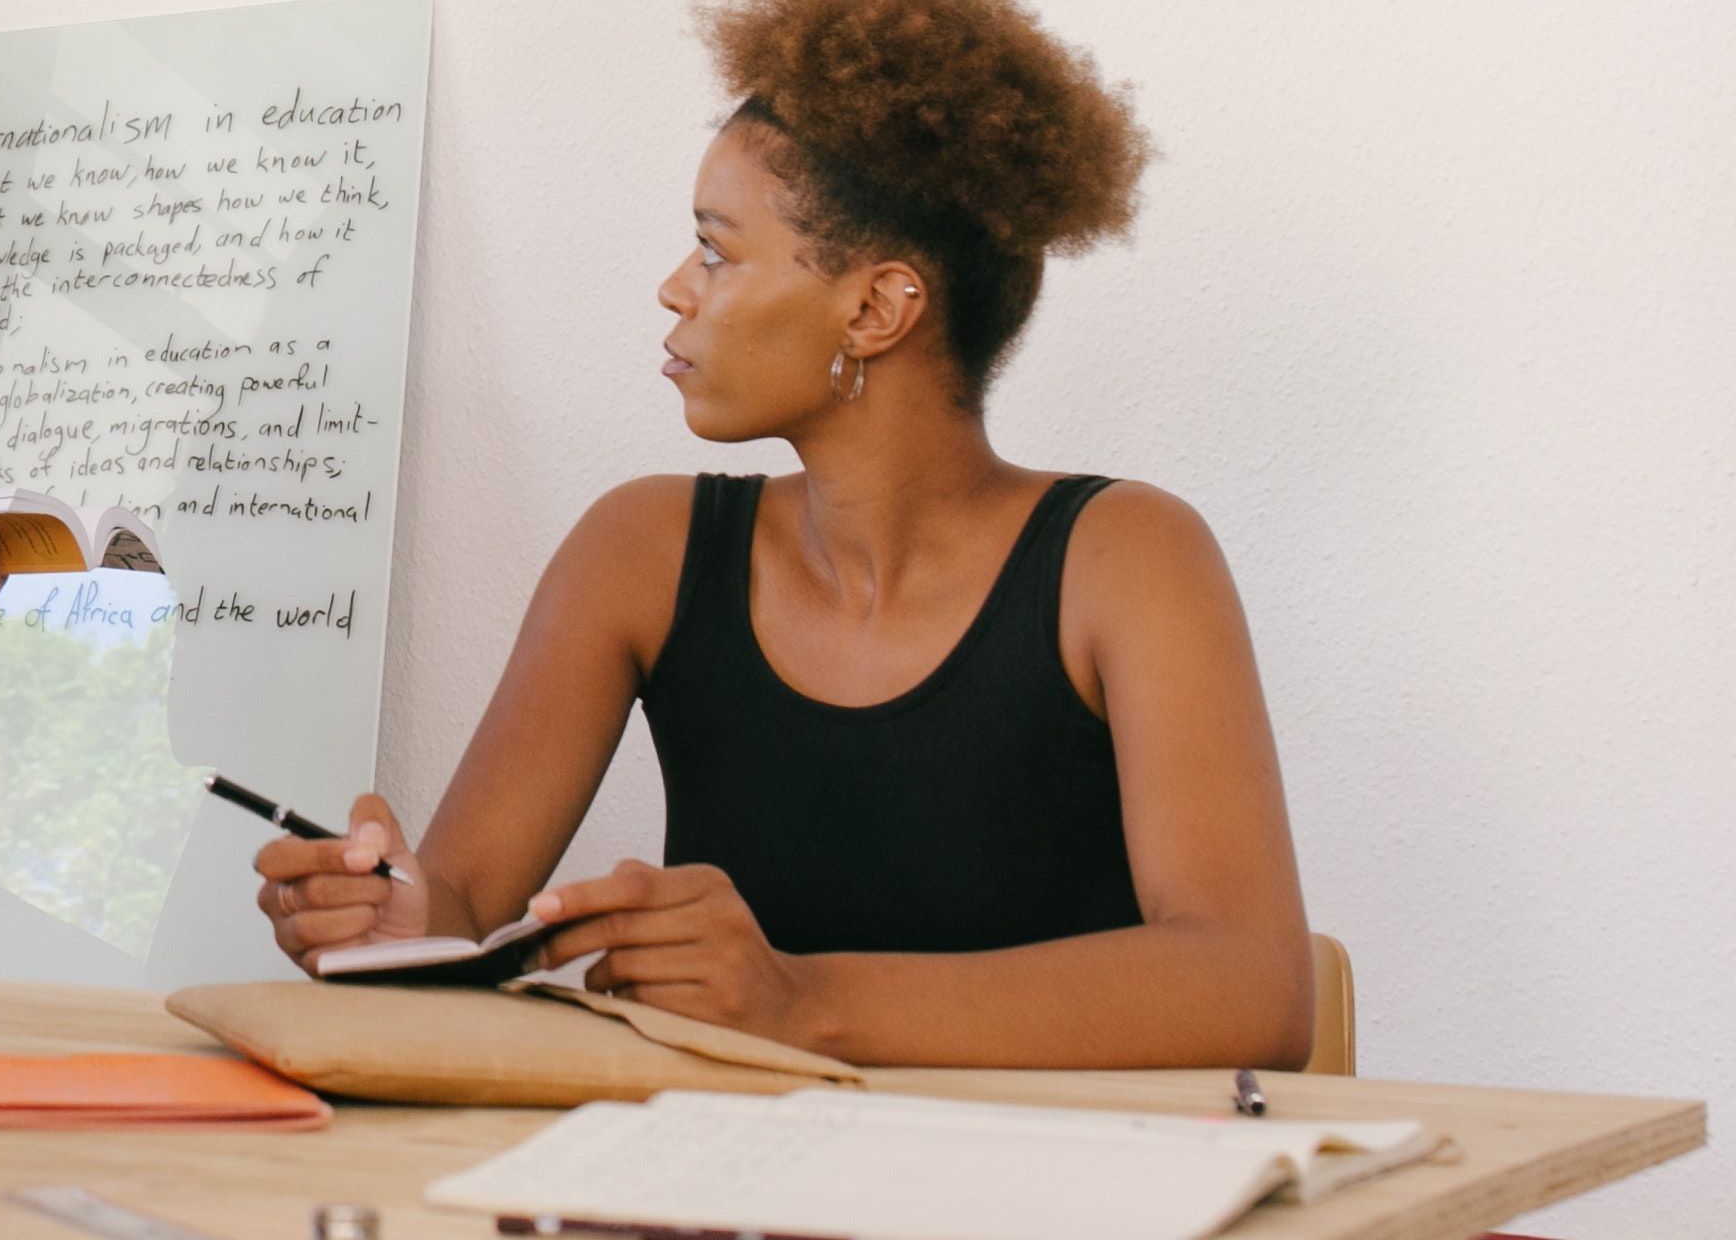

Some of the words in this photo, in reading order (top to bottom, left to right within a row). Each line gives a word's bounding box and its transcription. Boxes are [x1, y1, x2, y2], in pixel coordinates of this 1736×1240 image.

[205, 103, 233, 133] in
[262, 87, 401, 129] education
[27, 173, 55, 190] we
[70, 157, 137, 188] know,
[144, 154, 186, 180] how
[207, 157, 239, 174] we
[256, 146, 327, 173] know
[343, 139, 376, 170] it,
[21, 211, 46, 227] we
[56, 200, 114, 226] know
[133, 192, 203, 225] shapes
[216, 188, 264, 211] how
[278, 189, 307, 204] we
[320, 175, 389, 210] think,
[69, 240, 85, 262] is
[102, 224, 202, 266] packaged,
[215, 217, 272, 248] and
[278, 216, 324, 242] how
[335, 218, 356, 241] it
[0, 271, 35, 303] the
[52, 257, 278, 294] interconnectedness
[296, 253, 330, 288] of
[107, 348, 128, 368] in
[145, 332, 252, 362] education
[269, 339, 297, 355] as
[316, 339, 330, 350] a
[146, 374, 225, 417] creating
[238, 362, 328, 406] powerful
[7, 411, 101, 459] dialogue,
[109, 409, 248, 455] migrations,
[258, 404, 304, 438] and
[316, 401, 381, 434] limit-
[30, 448, 54, 478] of
[70, 446, 124, 479] ideas
[138, 437, 179, 471] and
[187, 443, 346, 482] relationships;
[177, 485, 220, 516] and
[229, 491, 371, 522] international
[25, 587, 59, 628] of
[65, 581, 133, 630] Africa
[151, 585, 204, 626] and
[214, 592, 256, 623] the
[276, 590, 356, 639] world
